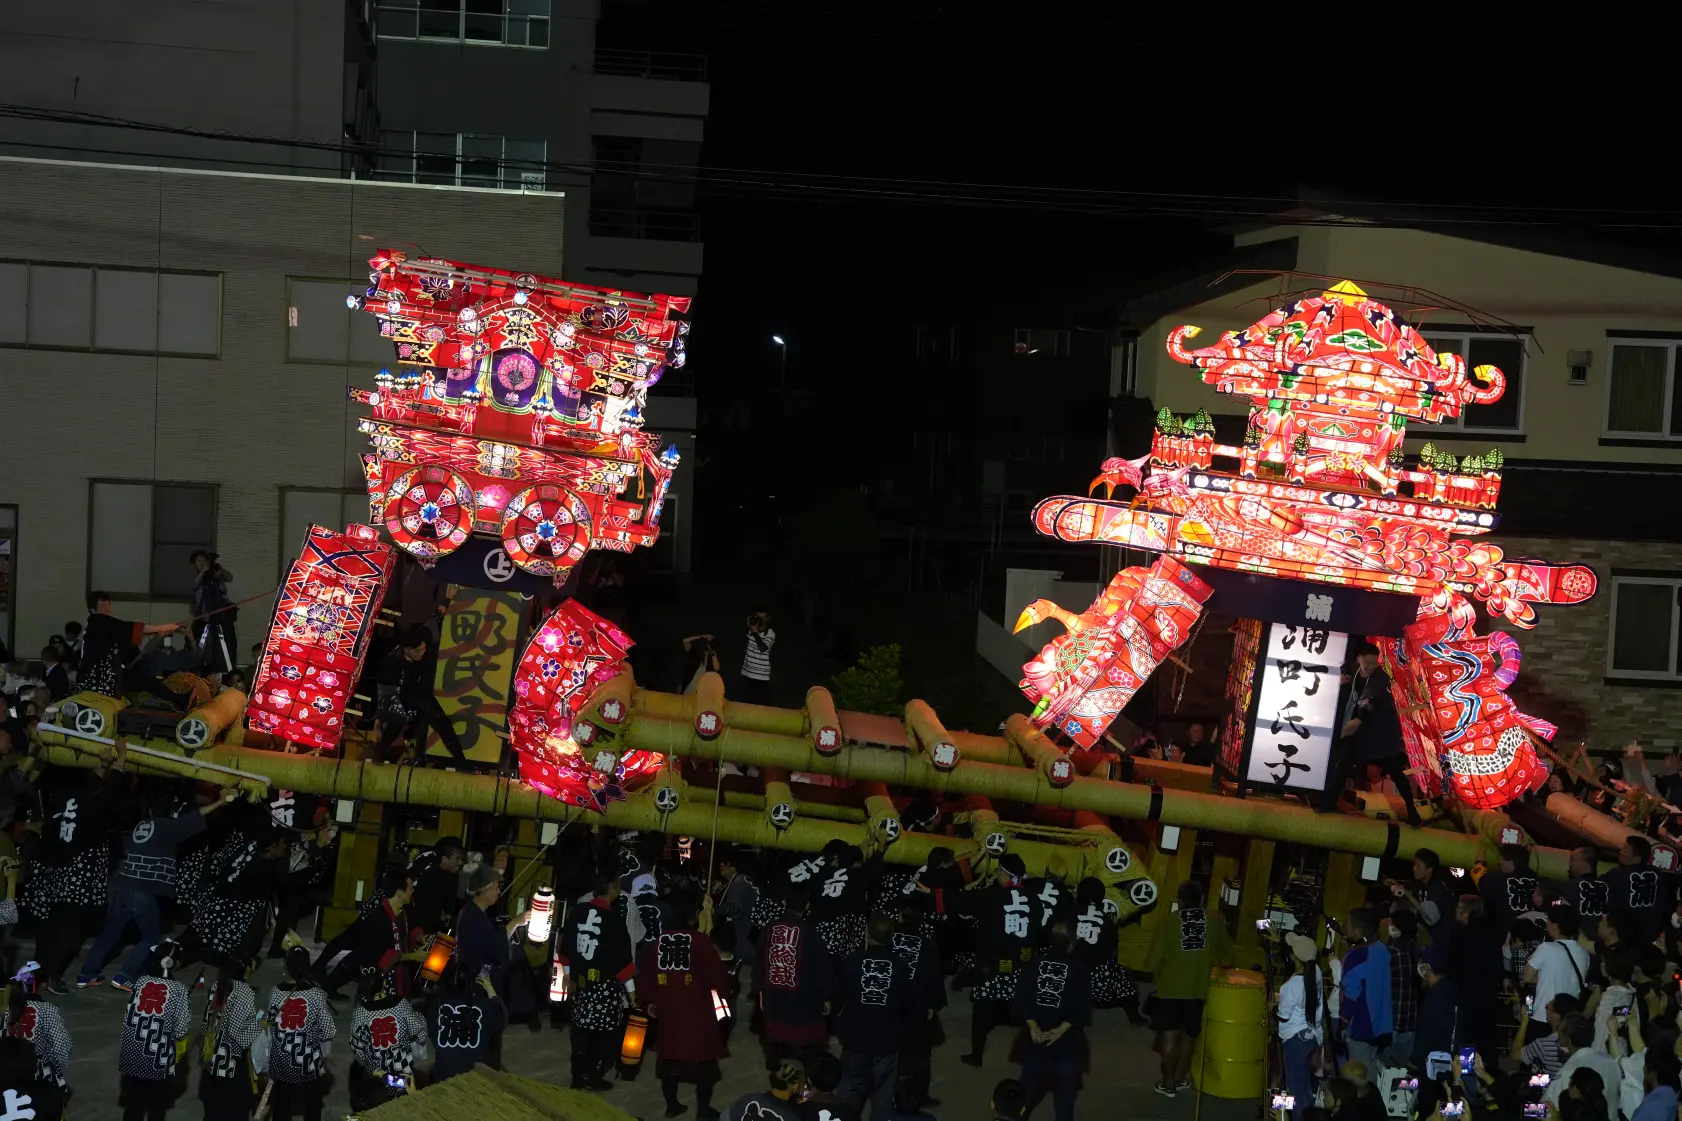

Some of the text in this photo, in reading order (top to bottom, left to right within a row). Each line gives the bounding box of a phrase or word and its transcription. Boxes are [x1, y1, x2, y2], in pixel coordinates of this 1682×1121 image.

[1305, 593, 1333, 622] 浦
[442, 588, 519, 750] 町氏子
[1263, 624, 1331, 785] 浦町氏子
[699, 713, 717, 731] 浦
[819, 729, 836, 746] 浦
[934, 743, 956, 764] 浦
[1053, 759, 1070, 778] 浦
[821, 867, 849, 898] 上町
[1003, 889, 1030, 938] 上町
[1076, 904, 1104, 945] 上町
[577, 908, 602, 961] 上町
[657, 932, 692, 971] 浦
[136, 981, 169, 1016] 祭
[279, 997, 308, 1031] 祭
[369, 1014, 399, 1049] 祭
[2, 1088, 36, 1121] 上
